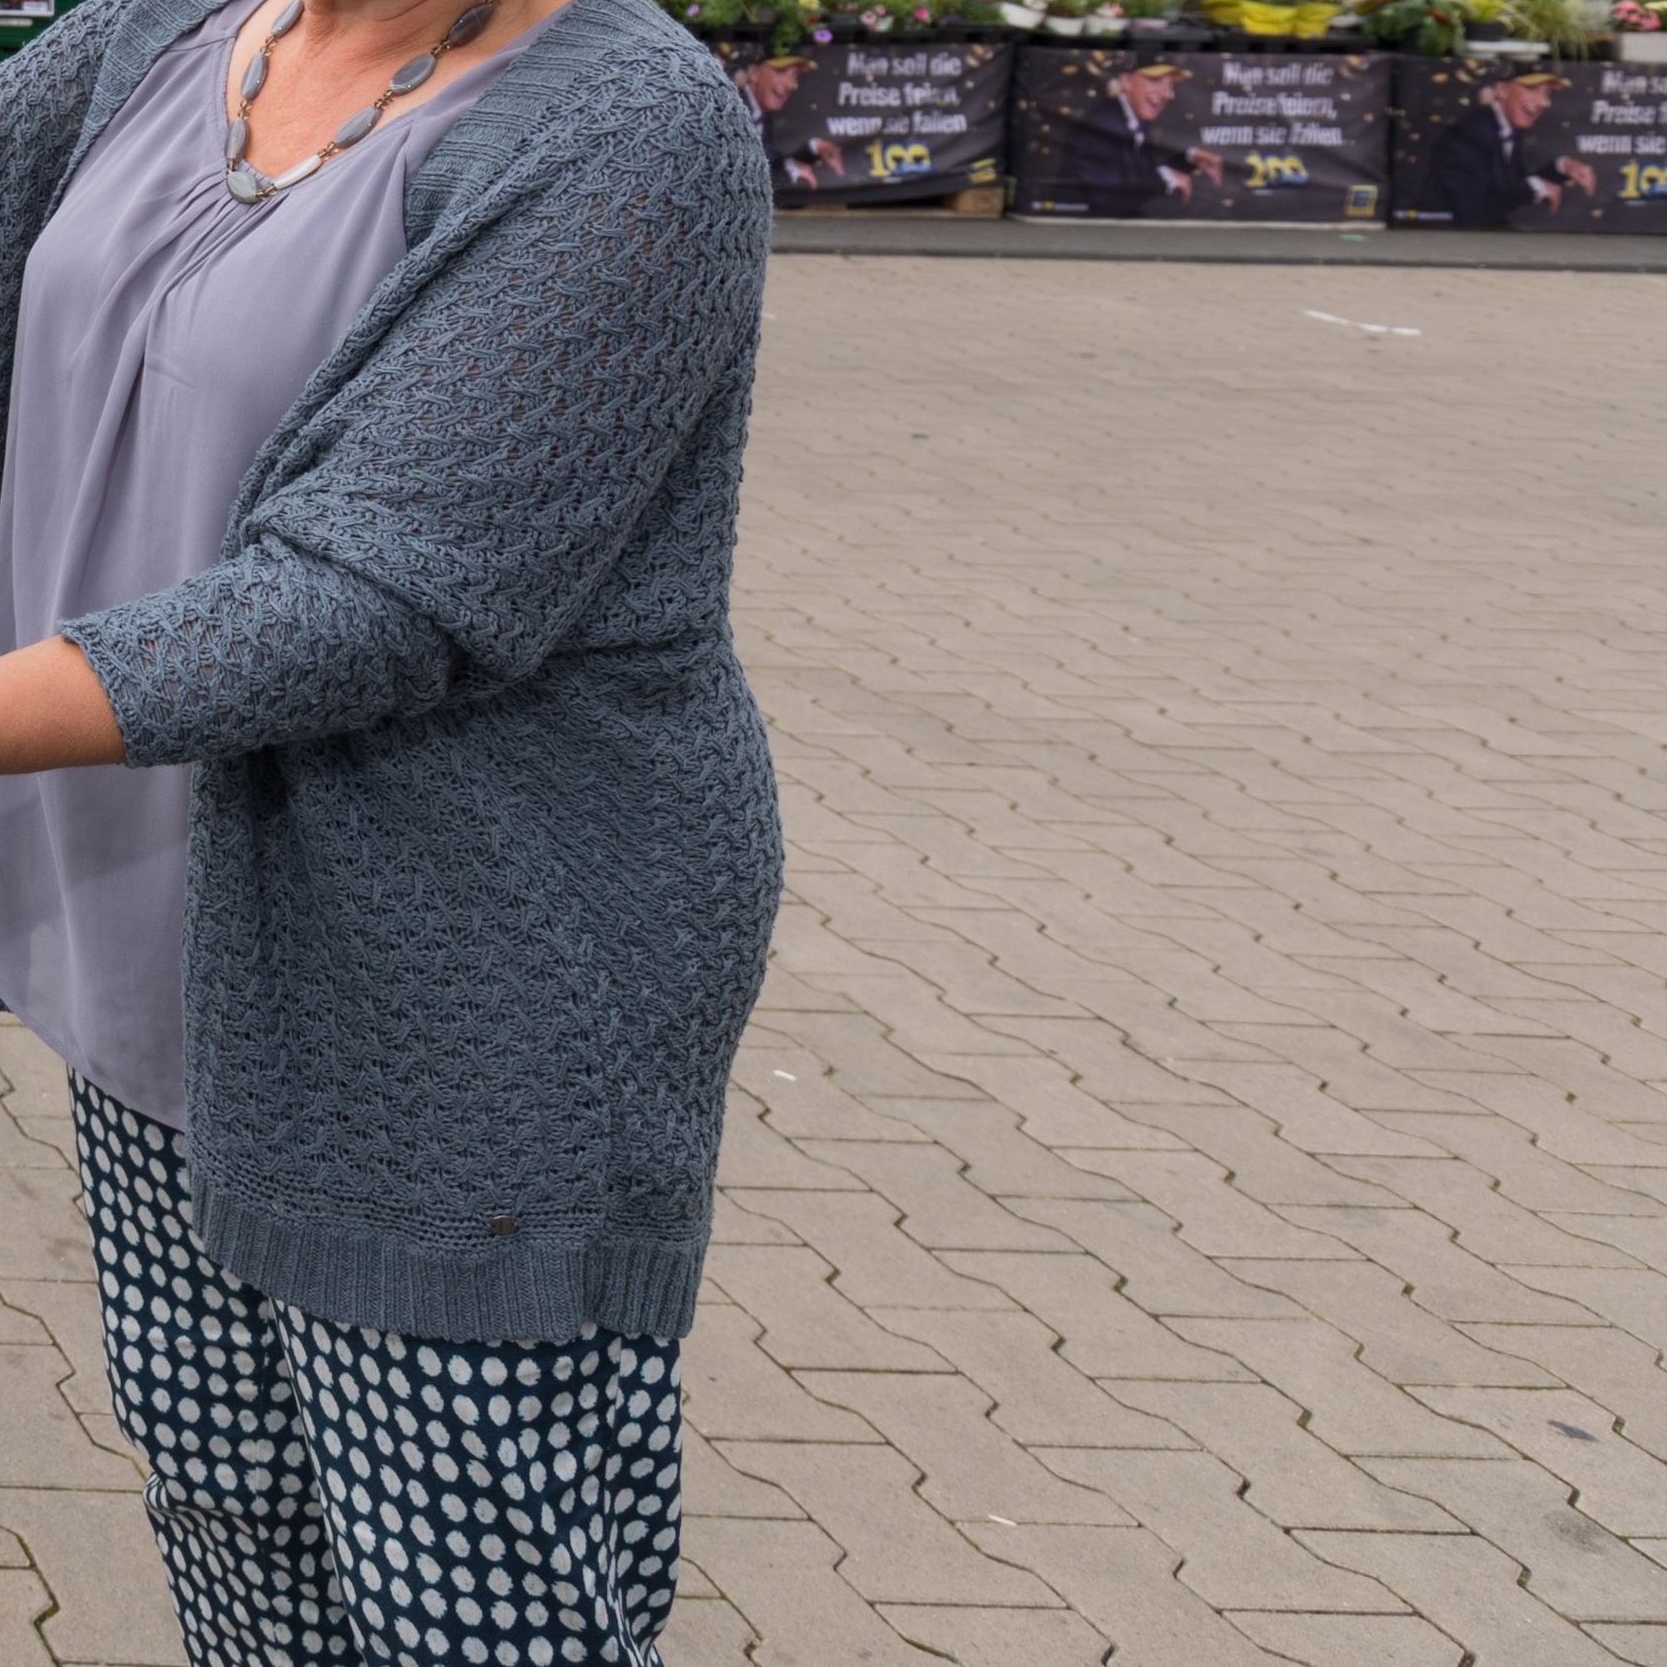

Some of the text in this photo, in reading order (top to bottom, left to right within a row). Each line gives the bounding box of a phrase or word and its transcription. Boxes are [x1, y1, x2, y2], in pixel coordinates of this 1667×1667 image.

[892, 52, 927, 76] soll
[930, 53, 962, 76] die
[838, 82, 901, 106] Preise
[826, 117, 882, 136] wenn
